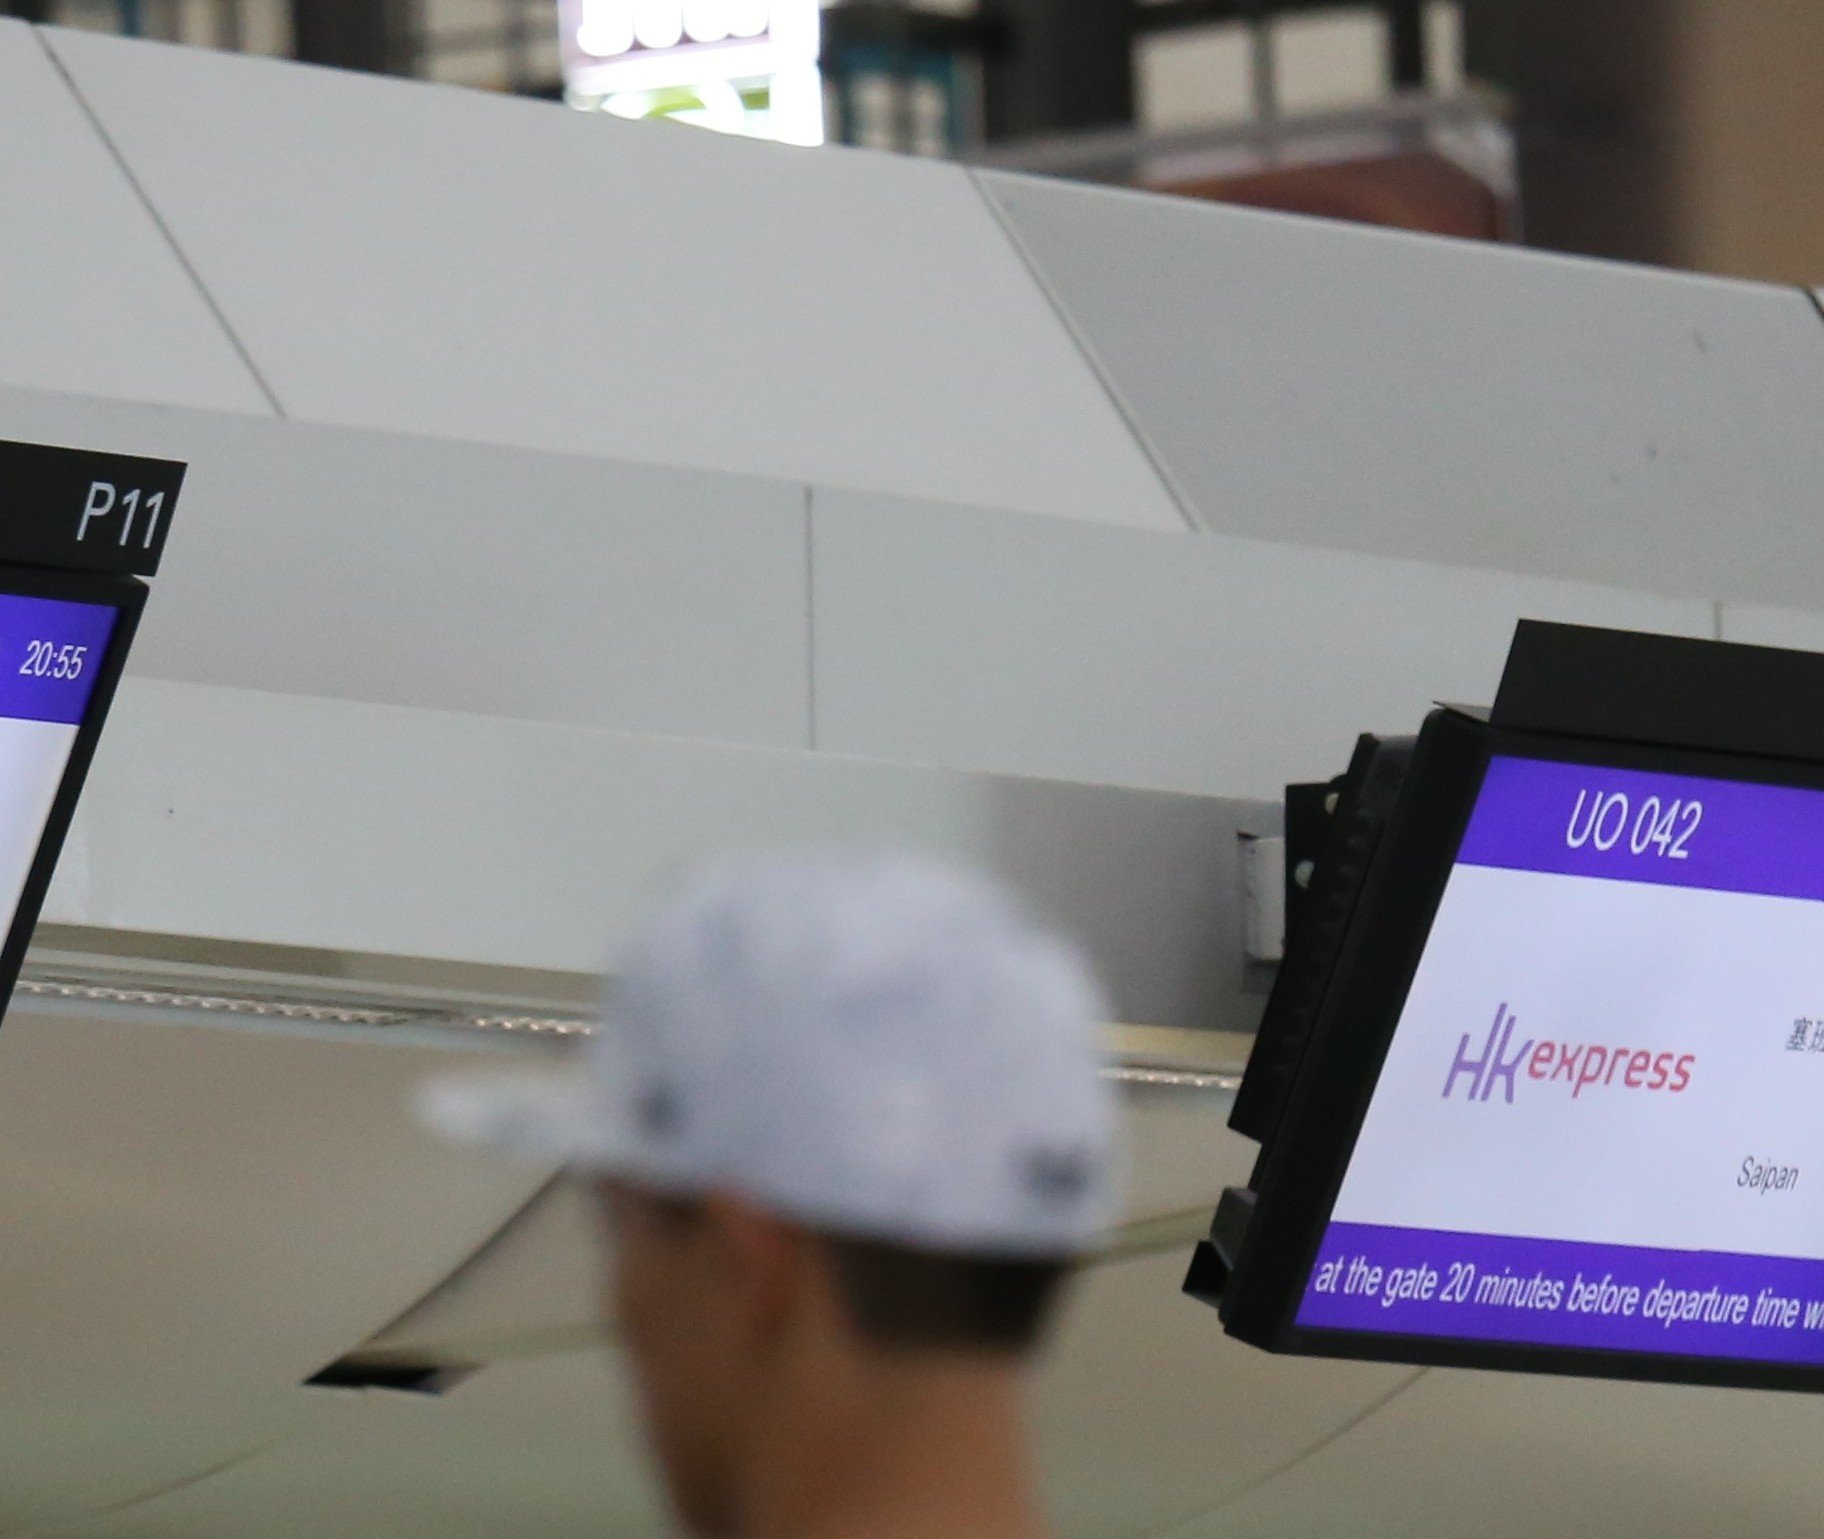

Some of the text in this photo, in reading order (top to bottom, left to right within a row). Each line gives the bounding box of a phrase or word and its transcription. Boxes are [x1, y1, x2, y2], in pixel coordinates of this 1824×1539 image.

[76, 481, 164, 549] P11
[19, 639, 87, 679] 20:55
[1566, 788, 1703, 859] UO 042
[1736, 1155, 1800, 1197] Saipan
[1314, 1255, 1344, 1294] at
[1343, 1255, 1383, 1297] the
[1381, 1261, 1438, 1308] gate
[1439, 1261, 1476, 1304] 20
[1475, 1266, 1565, 1311] minutes
[1566, 1271, 1640, 1317] before
[1643, 1278, 1749, 1329] departure
[1751, 1287, 1800, 1329] time
